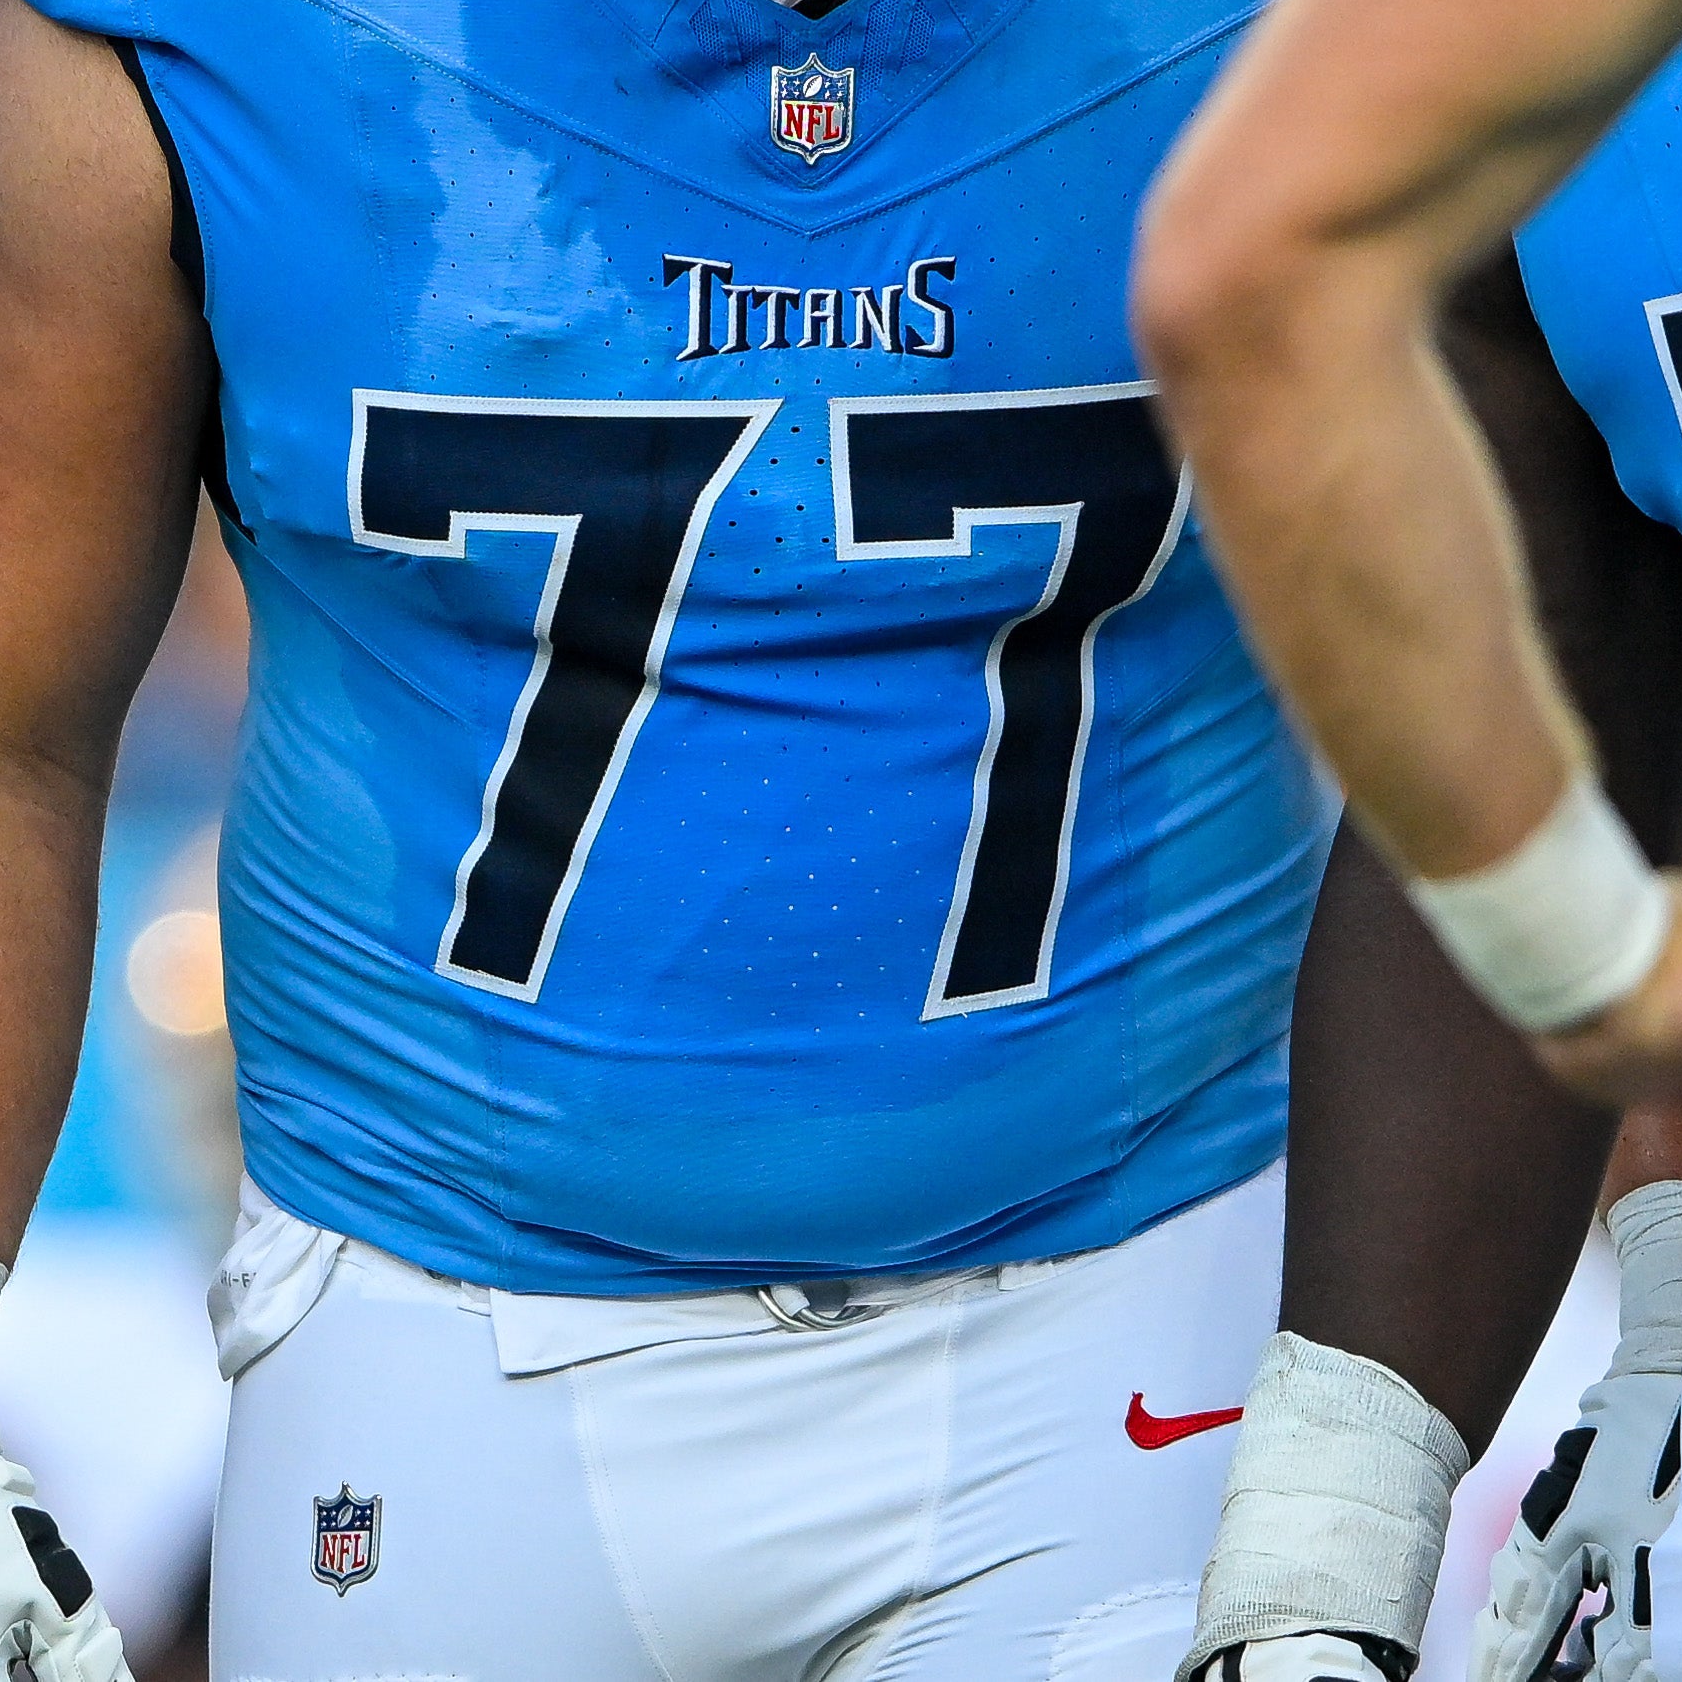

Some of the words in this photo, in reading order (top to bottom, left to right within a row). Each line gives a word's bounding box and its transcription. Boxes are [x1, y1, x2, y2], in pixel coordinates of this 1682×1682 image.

[783, 102, 840, 145] NFL
[662, 253, 956, 362] TITANS
[346, 378, 1191, 1022] 77
[319, 1532, 366, 1575] NFL
